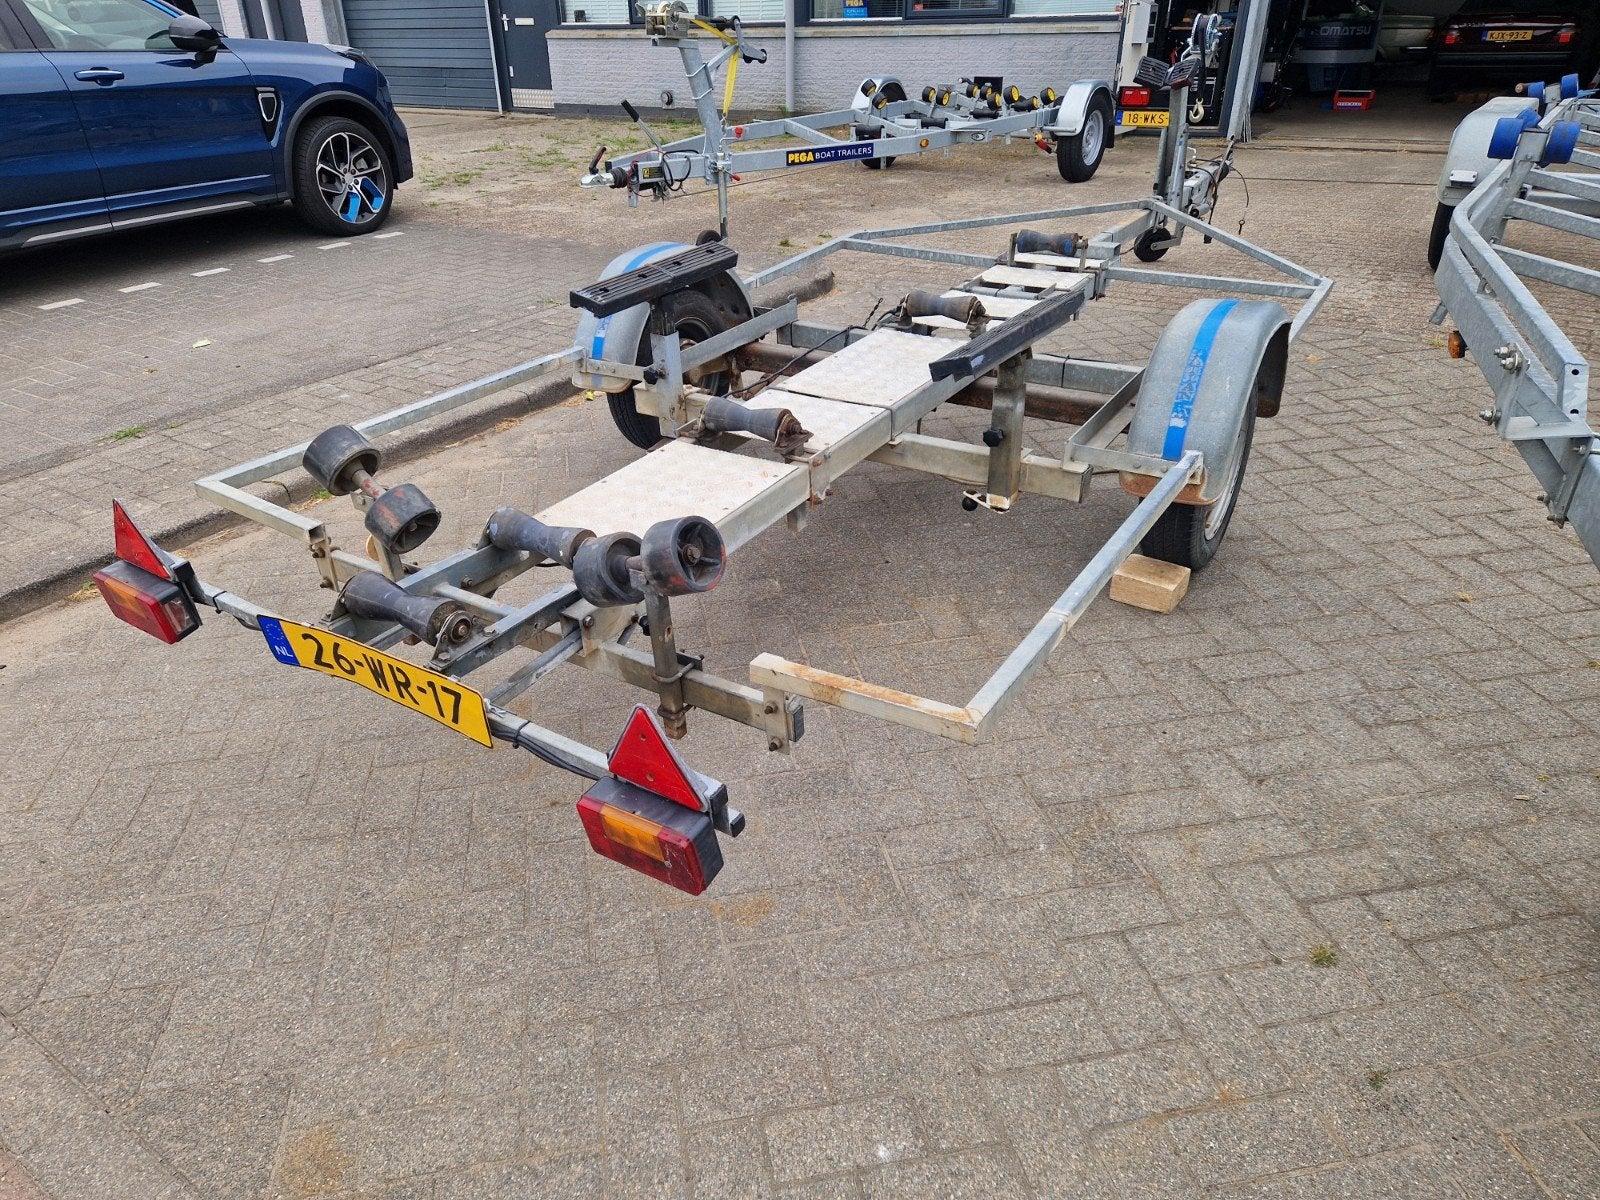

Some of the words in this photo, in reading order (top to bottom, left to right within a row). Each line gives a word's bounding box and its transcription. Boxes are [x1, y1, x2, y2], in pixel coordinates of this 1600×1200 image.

[1488, 31, 1528, 40] KJX-93-Z
[1128, 113, 1168, 124] 18-WKS-
[788, 151, 814, 163] PEGA
[815, 150, 836, 159] BOAT
[837, 146, 872, 157] TRAILERS
[275, 645, 293, 658] NL
[301, 632, 463, 725] 26-WR-17
